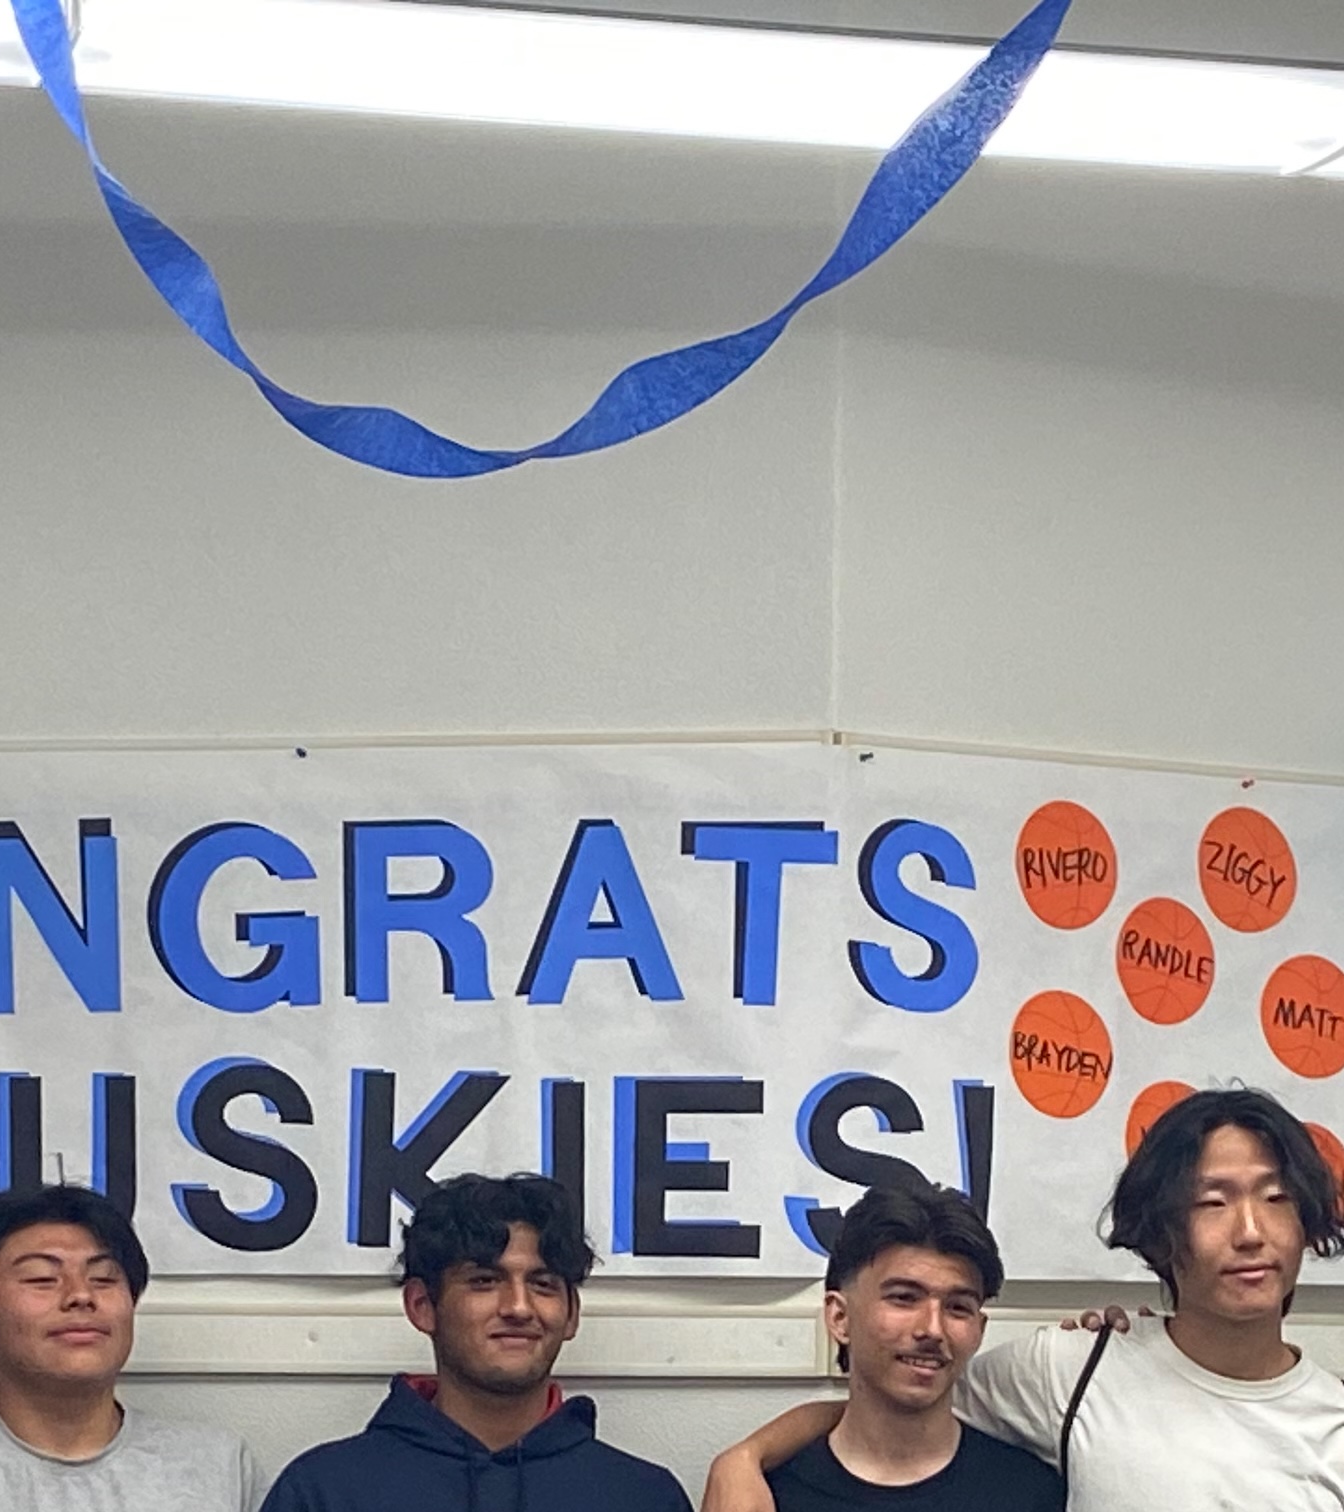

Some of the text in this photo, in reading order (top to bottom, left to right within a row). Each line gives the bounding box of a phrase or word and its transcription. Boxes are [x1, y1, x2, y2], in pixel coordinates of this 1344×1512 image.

[1023, 847, 1108, 889] RIVERO
[1202, 840, 1287, 910] ZIGGY
[1121, 929, 1215, 984] RANDLE
[1272, 997, 1344, 1041] MATT
[1012, 1030, 1113, 1081] BRAYDEN
